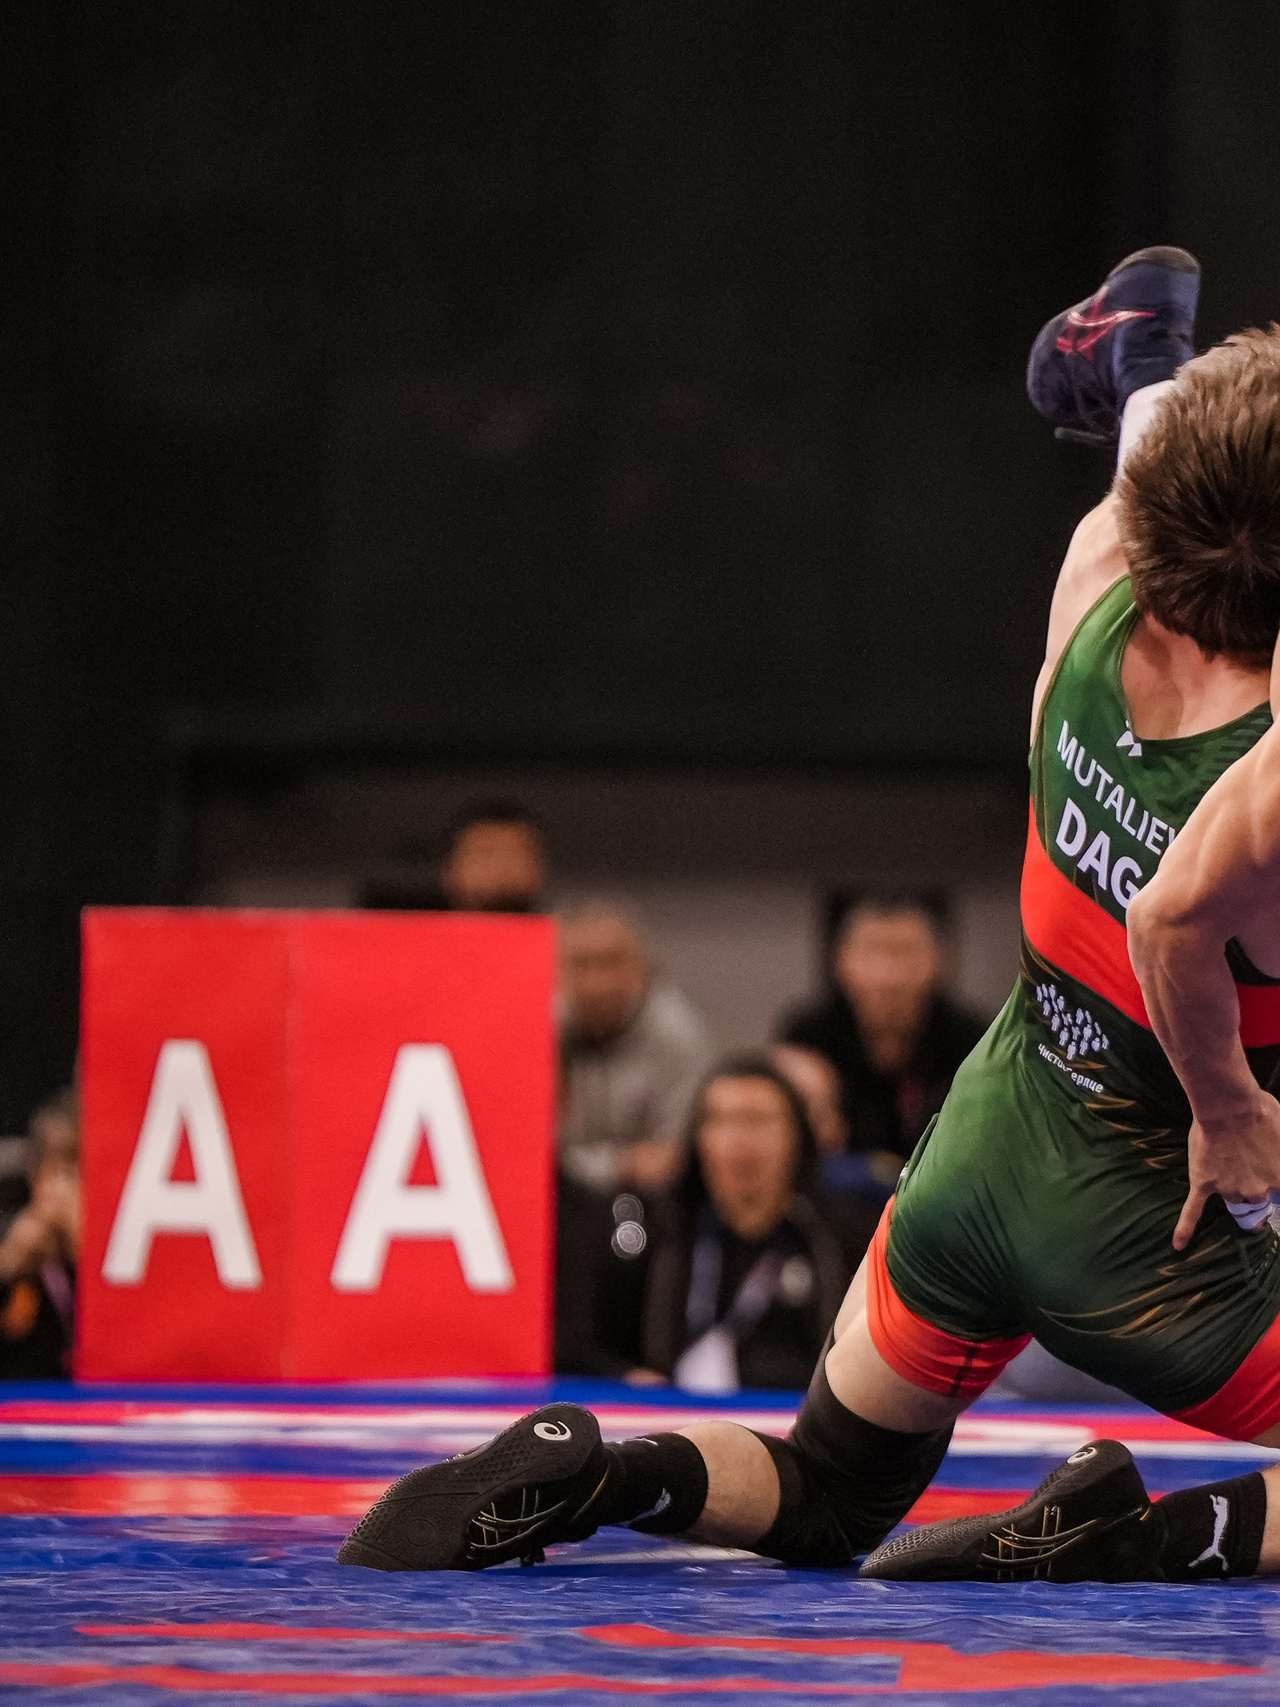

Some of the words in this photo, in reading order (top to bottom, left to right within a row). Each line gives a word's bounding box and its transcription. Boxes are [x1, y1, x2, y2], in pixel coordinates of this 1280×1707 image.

[1056, 797, 1143, 910] DAG
[101, 1039, 262, 1289] A
[330, 1043, 515, 1294] A
